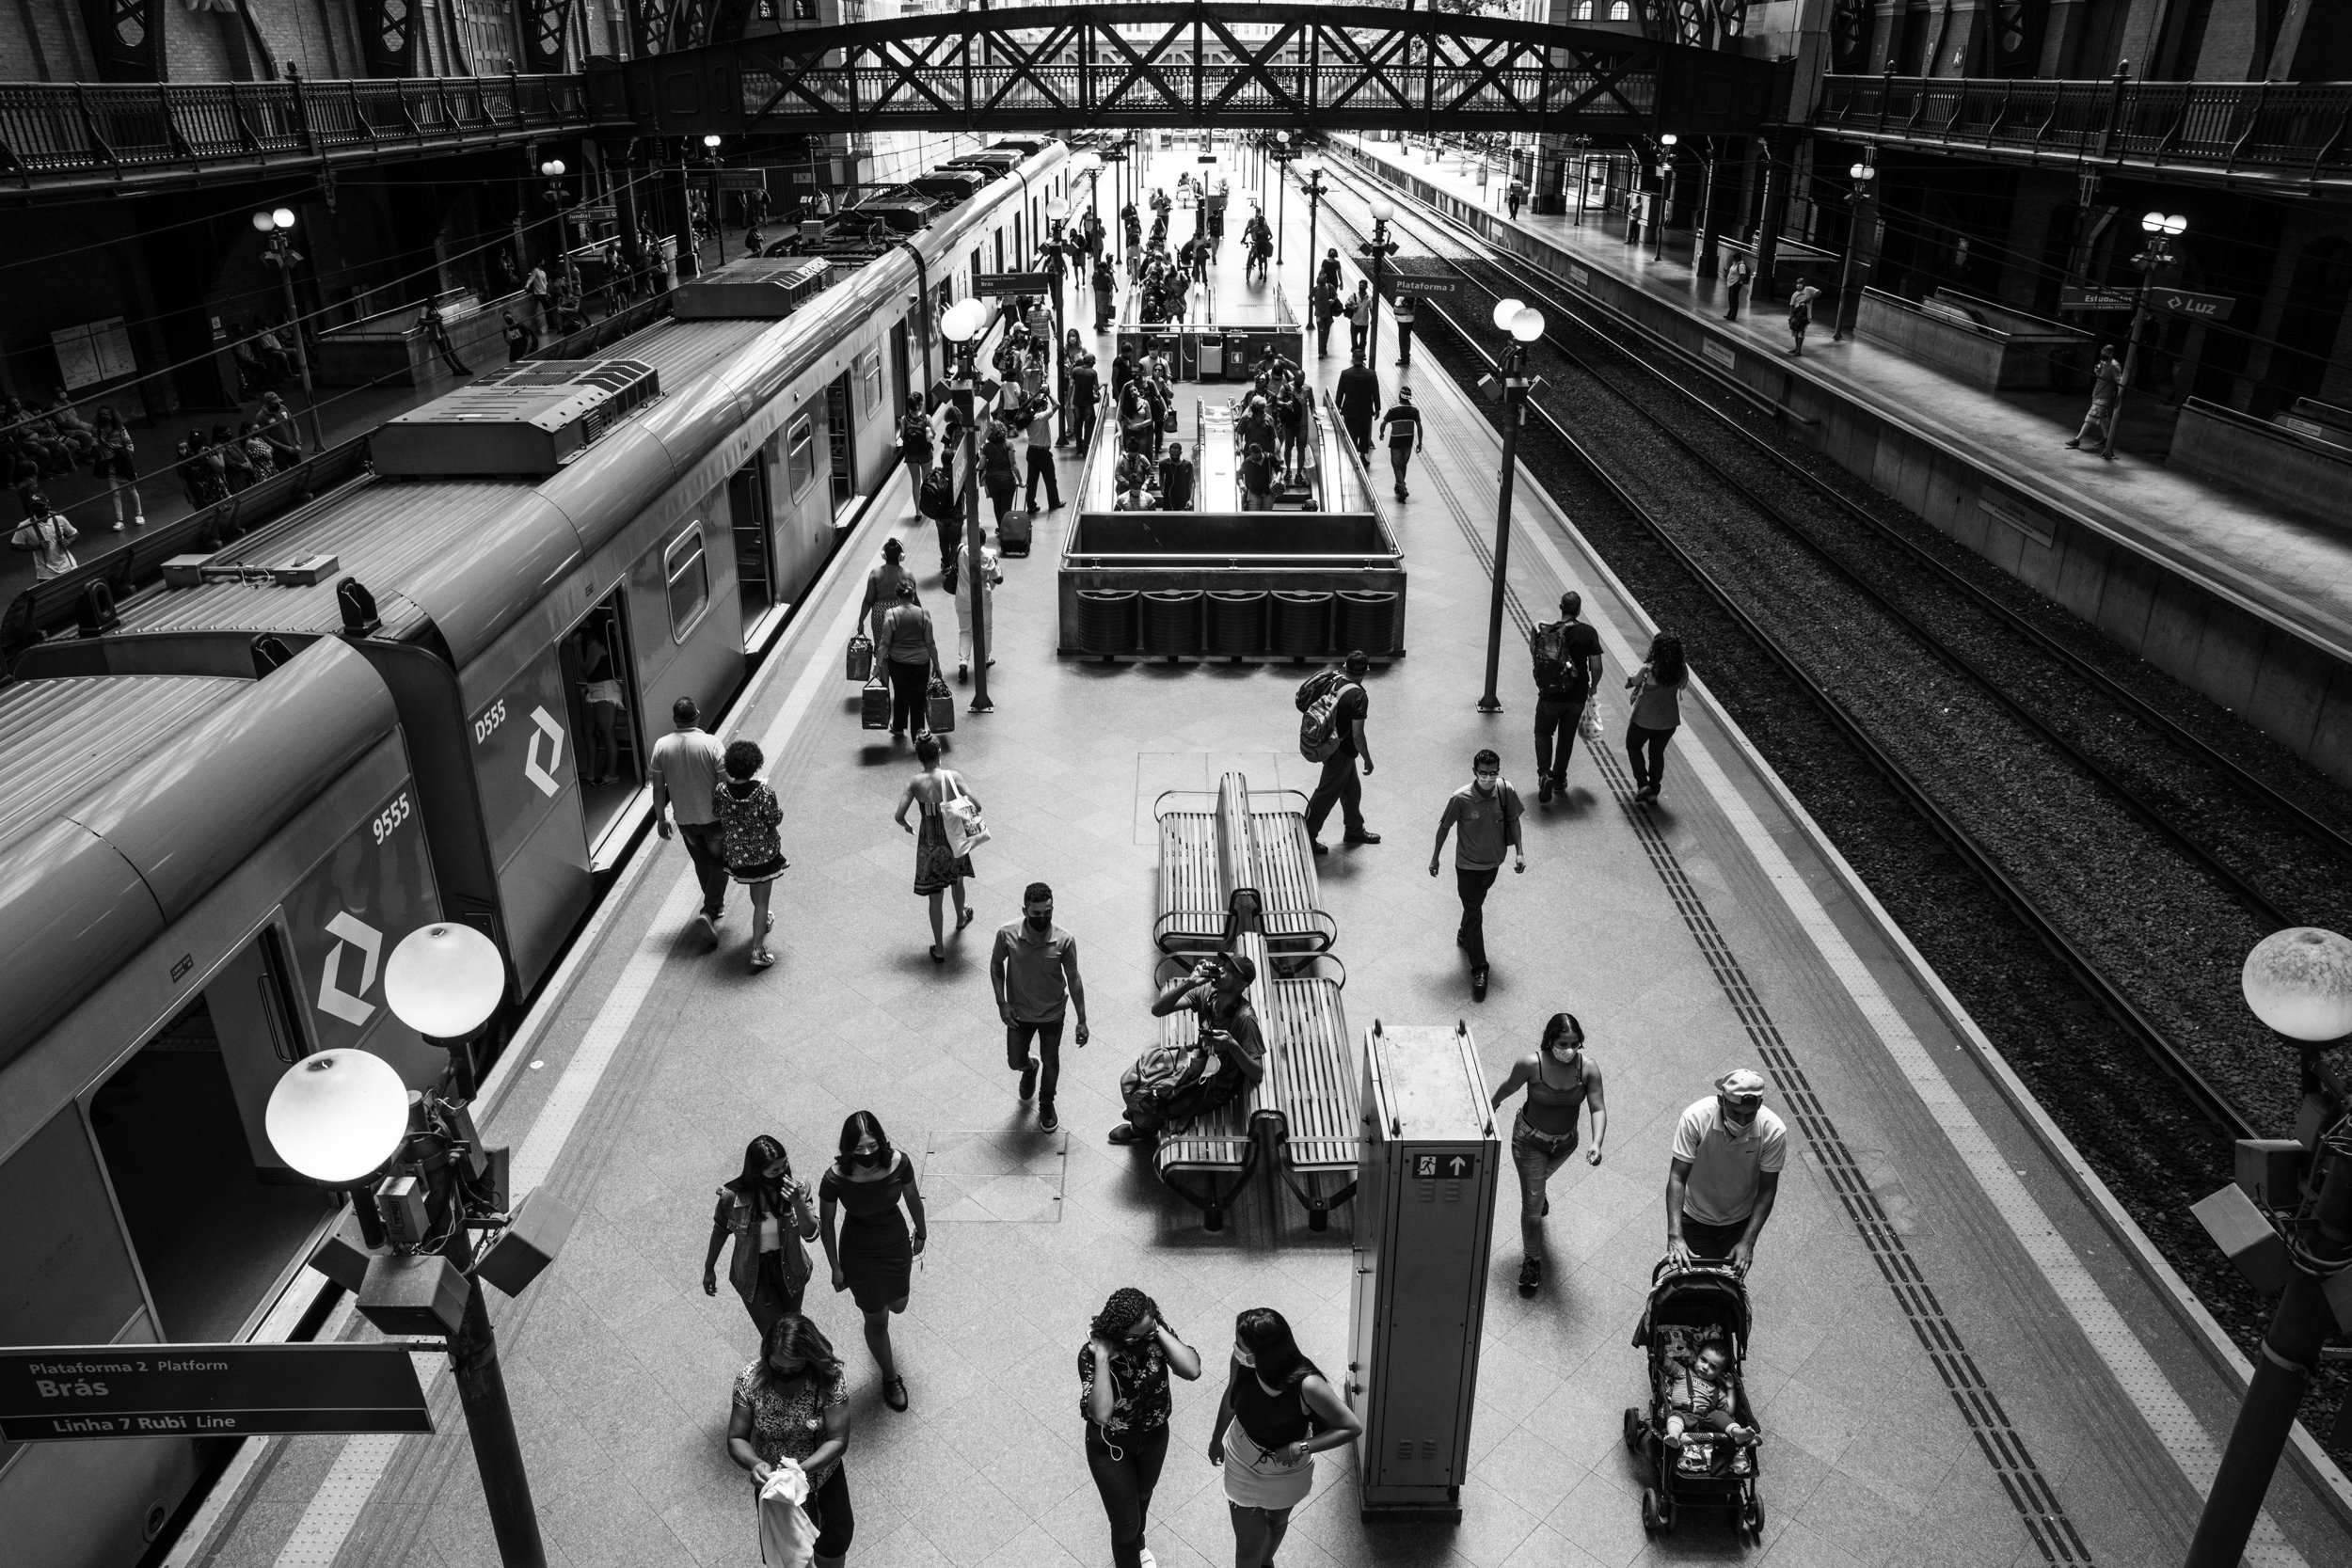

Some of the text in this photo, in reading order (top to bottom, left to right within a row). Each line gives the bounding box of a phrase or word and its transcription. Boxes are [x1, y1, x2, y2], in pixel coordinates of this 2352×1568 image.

[1396, 280, 1447, 292] Plataforma
[2185, 298, 2217, 315] Luz
[474, 698, 506, 745] D555
[373, 792, 410, 846] 9555
[28, 1359, 229, 1375] Plataforma 2 Platform
[36, 1378, 109, 1398] Brás
[53, 1416, 236, 1433] Linha 7 Rubi Line
